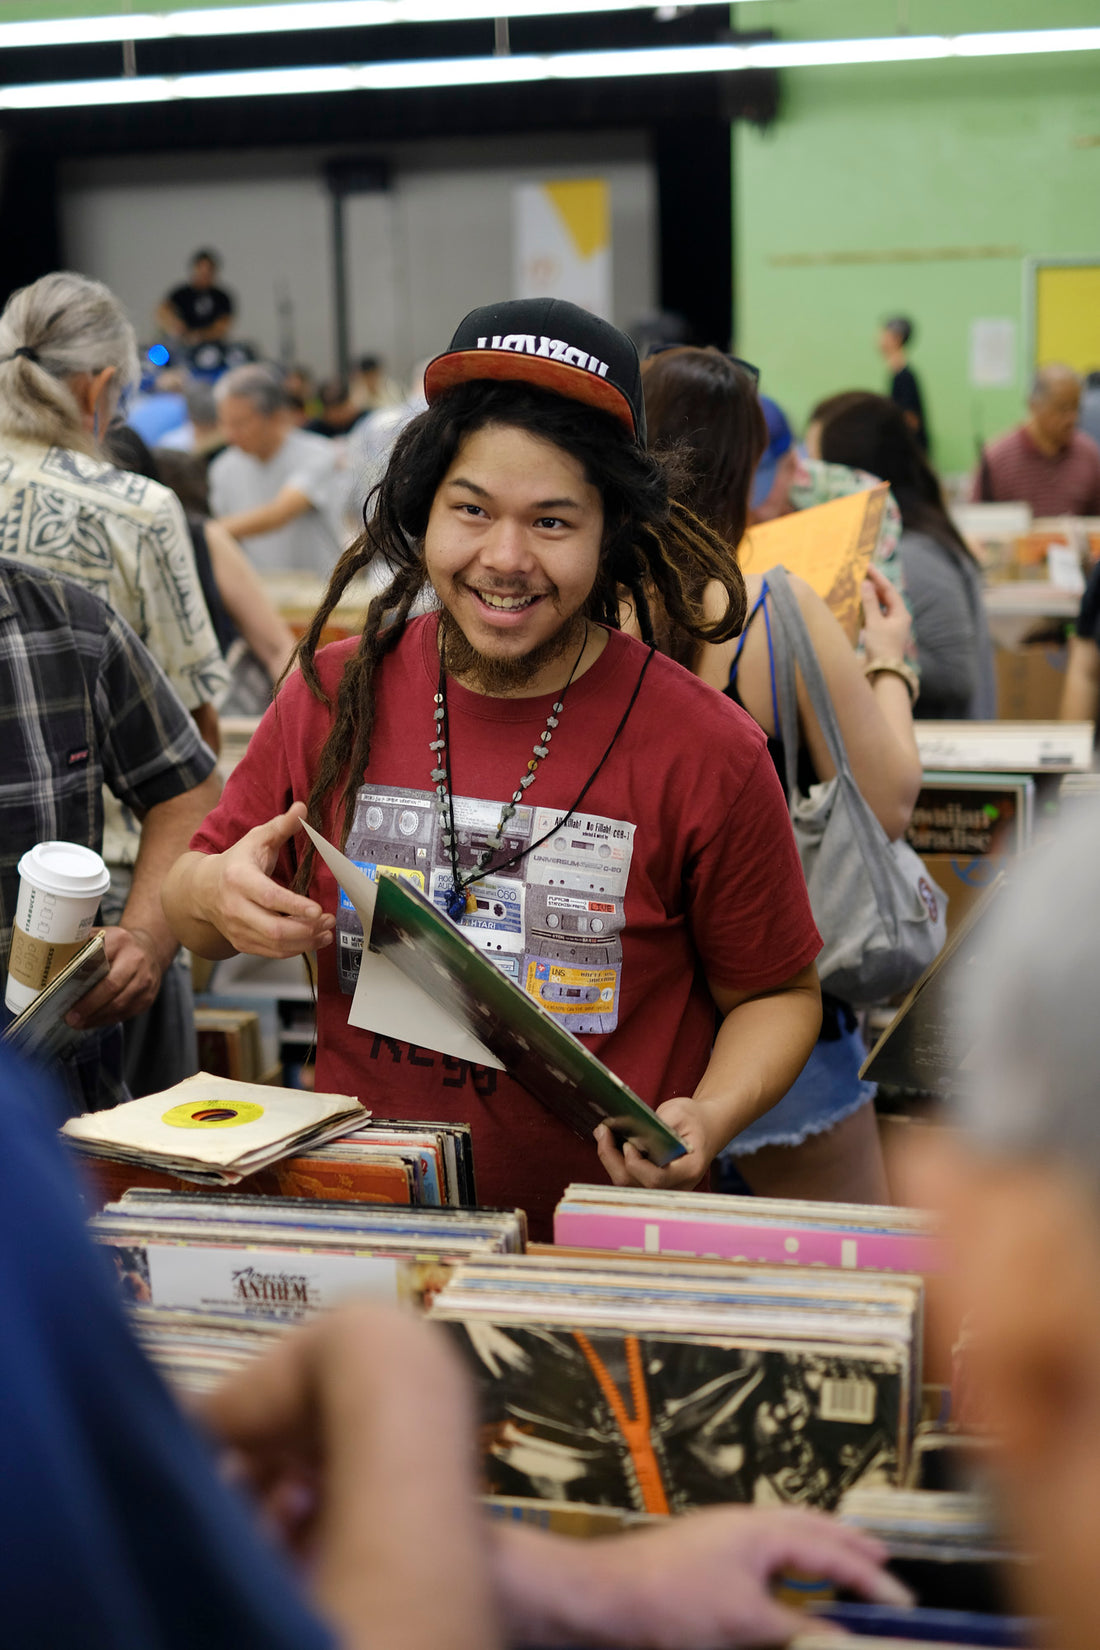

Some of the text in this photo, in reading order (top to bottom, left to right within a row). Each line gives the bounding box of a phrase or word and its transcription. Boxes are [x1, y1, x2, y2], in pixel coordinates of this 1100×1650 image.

[533, 855, 579, 868] UNIVERSUM
[496, 888, 517, 902] C60
[25, 890, 36, 932] STARBUCKS
[590, 902, 613, 913] LIVE
[41, 947, 55, 988] STARBUCKS
